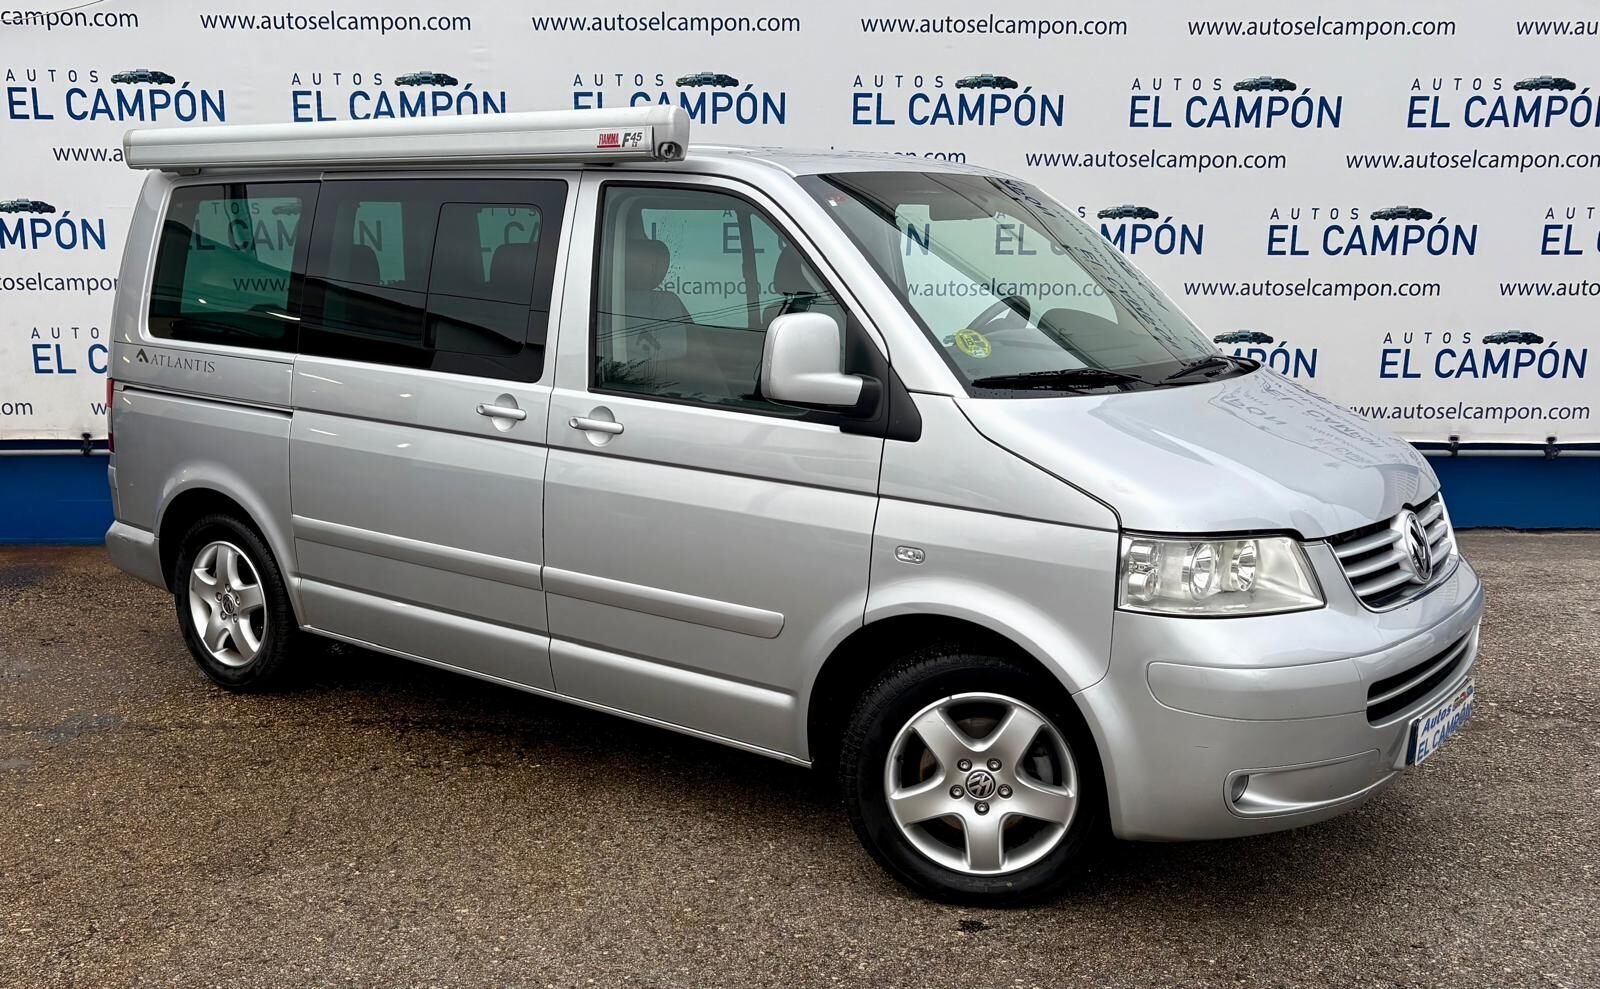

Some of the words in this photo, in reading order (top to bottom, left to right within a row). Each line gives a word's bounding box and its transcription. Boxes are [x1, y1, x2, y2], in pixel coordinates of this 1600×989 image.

[200, 11, 470, 35] www.autoselcampon.com
[532, 12, 799, 36] www.autoselcampon.com
[861, 14, 1126, 39] www.autoselcampon.com
[1188, 16, 1455, 40] www.autoselcampon.com
[1517, 22, 1598, 35] www.au
[6, 69, 98, 82] AUTOS
[292, 73, 382, 85] AUTOS
[574, 74, 663, 86] AUTOS
[854, 75, 943, 88] AUTOS
[1132, 78, 1221, 90] AUTOS
[1411, 78, 1502, 90] AUTOS
[7, 87, 54, 120] EL
[65, 83, 226, 122] CAMPÓN
[293, 91, 336, 122] EL
[853, 93, 895, 125] EL
[909, 87, 1064, 126] CAMPÓN
[1130, 96, 1172, 127] EL
[1184, 88, 1343, 129] CAMPÓN
[1408, 96, 1450, 128] EL
[1464, 88, 1600, 128] CAMPÓ
[1026, 149, 1285, 173] www.autoselcampon.com
[1270, 208, 1358, 220] AUTOS
[1268, 225, 1309, 255] EL
[1320, 217, 1478, 256] CAMPÓN
[1541, 224, 1583, 255] EL
[0, 272, 119, 295] oselcampo
[1184, 278, 1440, 300] www.autoselcampon.com
[1384, 332, 1470, 344] AUTOS
[32, 344, 76, 374] EL
[150, 354, 216, 374] ATLANTIS
[1380, 349, 1421, 378] EL
[1432, 341, 1588, 379] CAMPÓN
[1421, 704, 1452, 737] Autos
